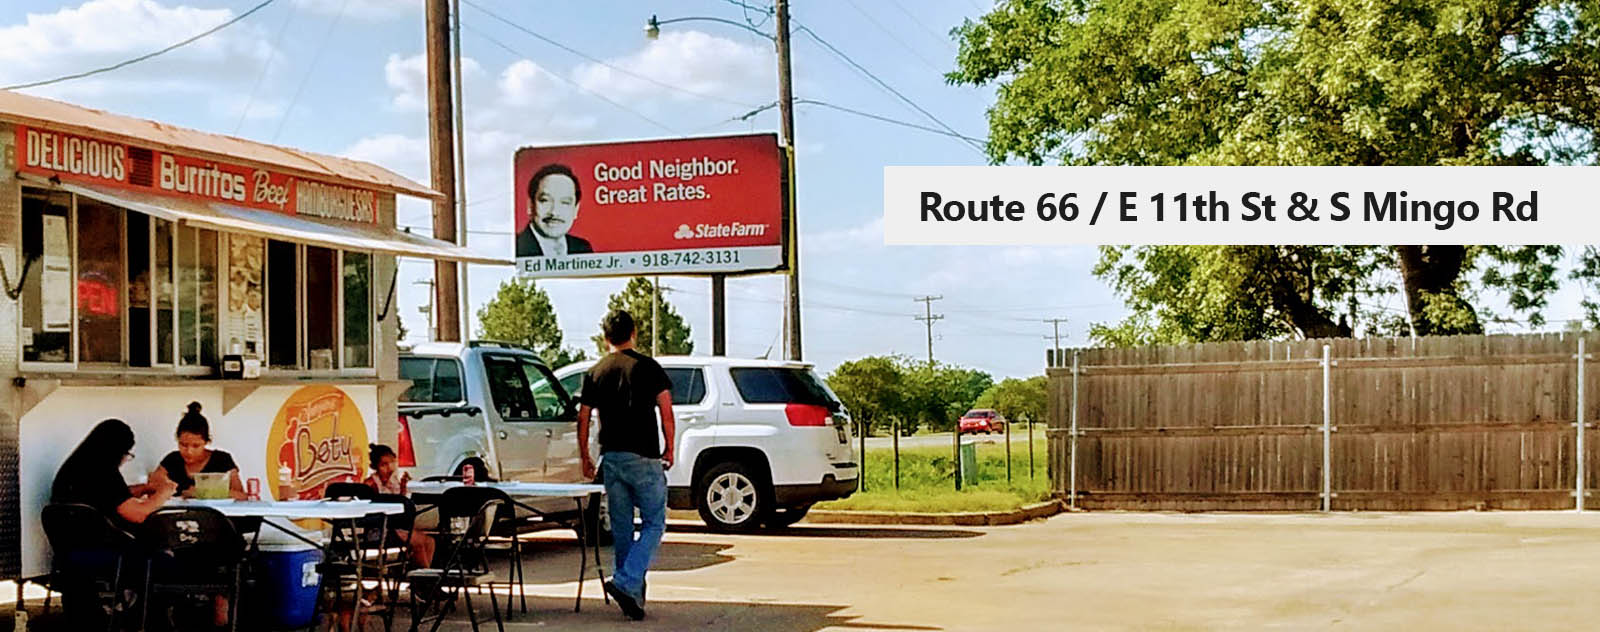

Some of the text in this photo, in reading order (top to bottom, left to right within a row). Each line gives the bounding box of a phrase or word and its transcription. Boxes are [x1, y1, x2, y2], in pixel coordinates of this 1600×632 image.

[26, 129, 126, 182] DELICIOUS
[159, 154, 247, 202] Burritos
[252, 168, 294, 210] Beef
[593, 156, 739, 182] Good Neighbor.
[594, 181, 712, 205] Great Rates.
[524, 250, 741, 273] Ed Martinez Jr. 918-742-3131
